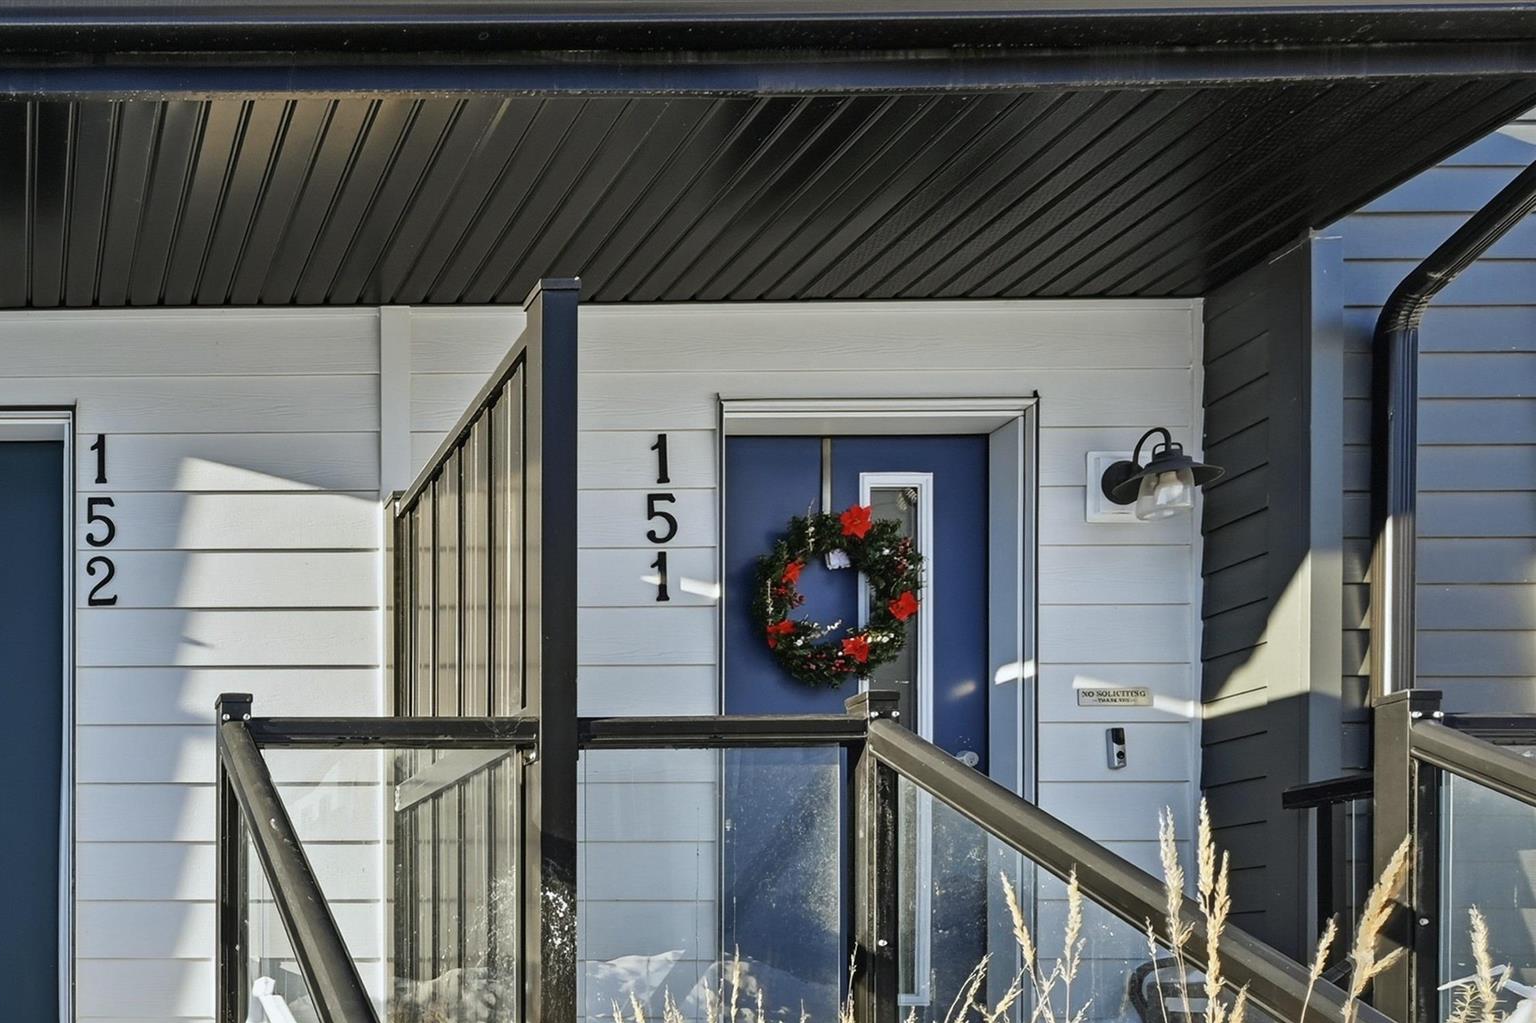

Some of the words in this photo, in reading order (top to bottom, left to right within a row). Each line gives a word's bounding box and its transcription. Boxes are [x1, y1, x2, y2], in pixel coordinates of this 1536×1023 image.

[86, 433, 118, 606] 152
[646, 433, 678, 602] 151
[1081, 690, 1095, 698] NO
[1096, 690, 1146, 698] SOLICITING
